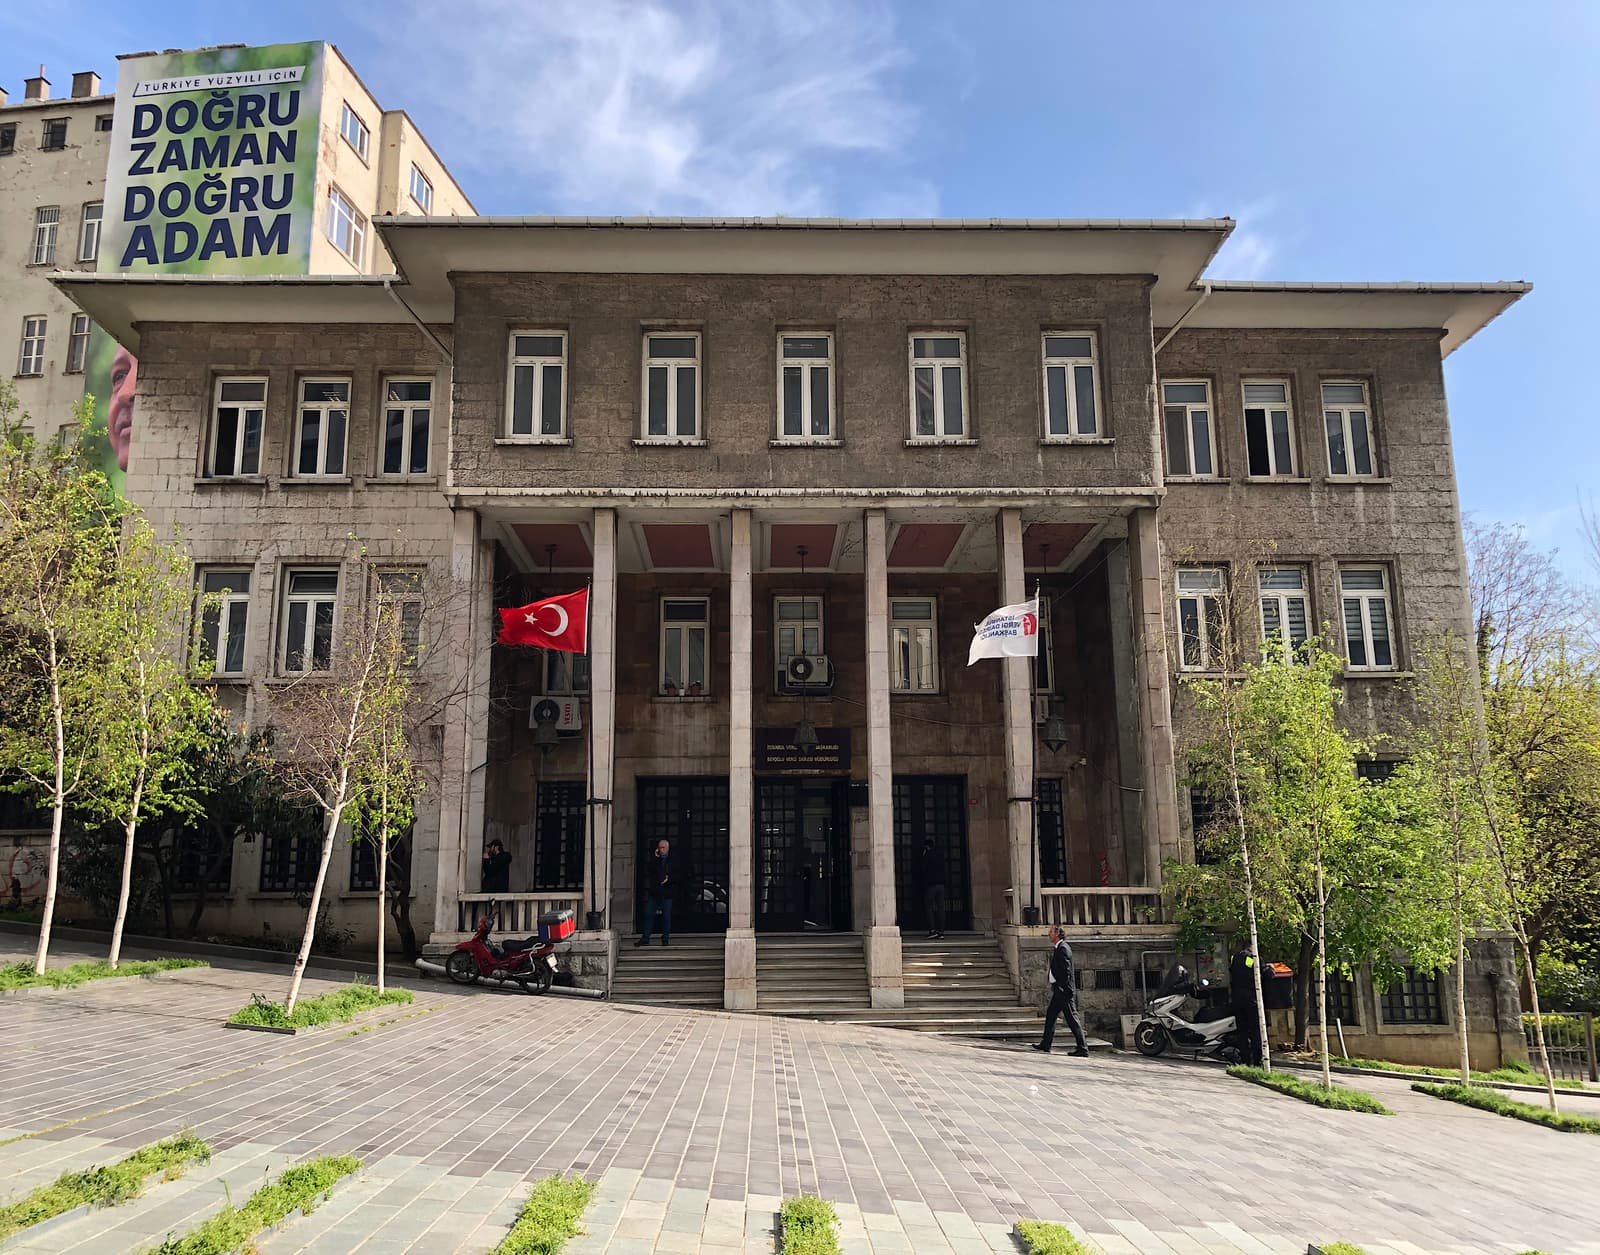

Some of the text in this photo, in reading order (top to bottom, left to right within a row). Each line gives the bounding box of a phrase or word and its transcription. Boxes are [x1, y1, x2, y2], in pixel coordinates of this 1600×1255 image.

[132, 90, 300, 139] DOĞRU
[128, 130, 298, 176] ZAMAN
[124, 172, 294, 222] DOĞRU
[120, 213, 291, 267] ADAM
